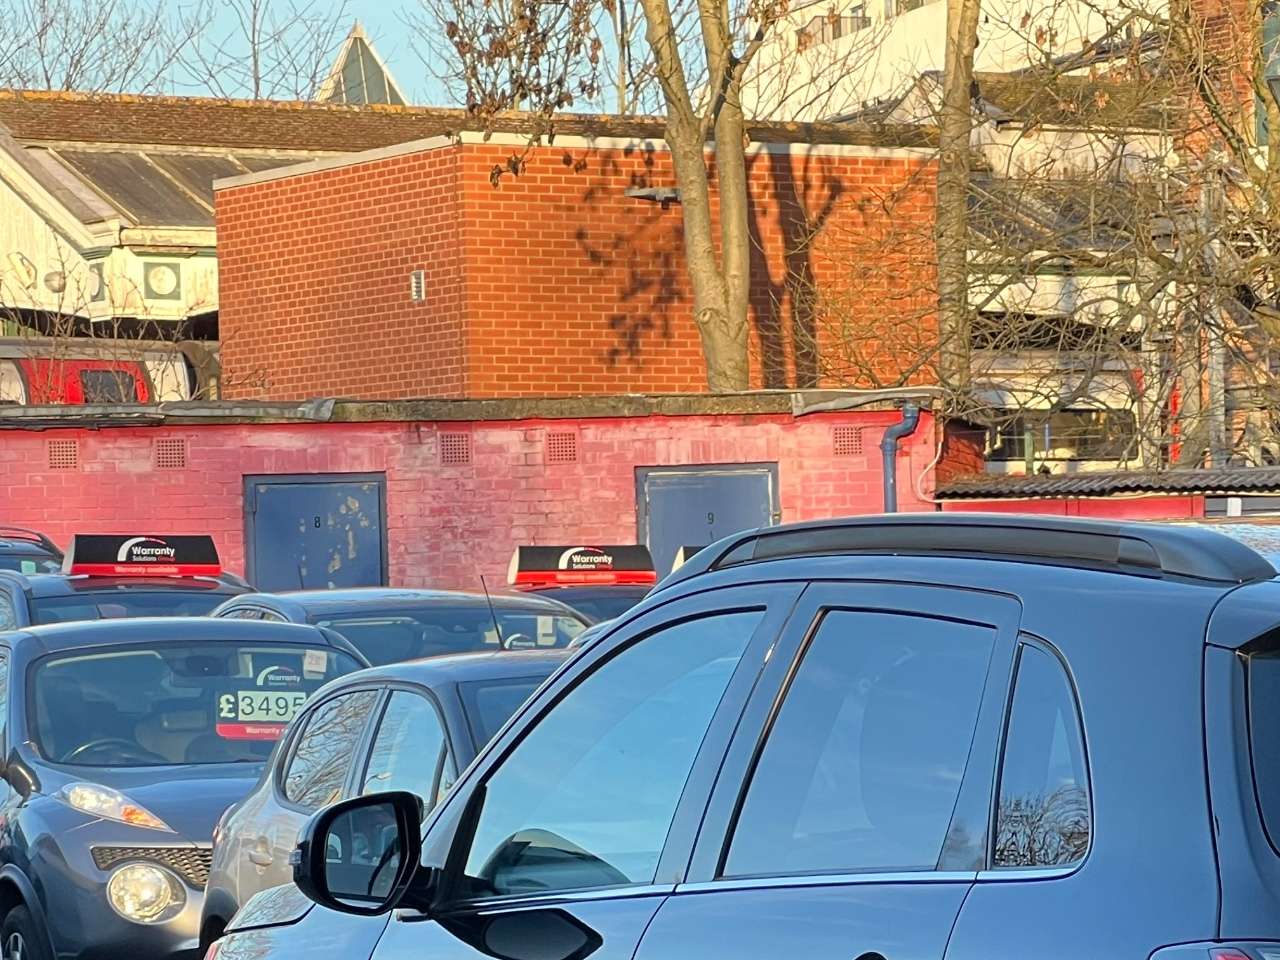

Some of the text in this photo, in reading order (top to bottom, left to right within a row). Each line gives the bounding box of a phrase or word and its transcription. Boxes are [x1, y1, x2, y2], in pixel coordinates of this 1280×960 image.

[314, 516, 321, 529] 8
[707, 511, 714, 525] 9
[131, 546, 176, 557] Warranty
[572, 554, 613, 565] Warranty
